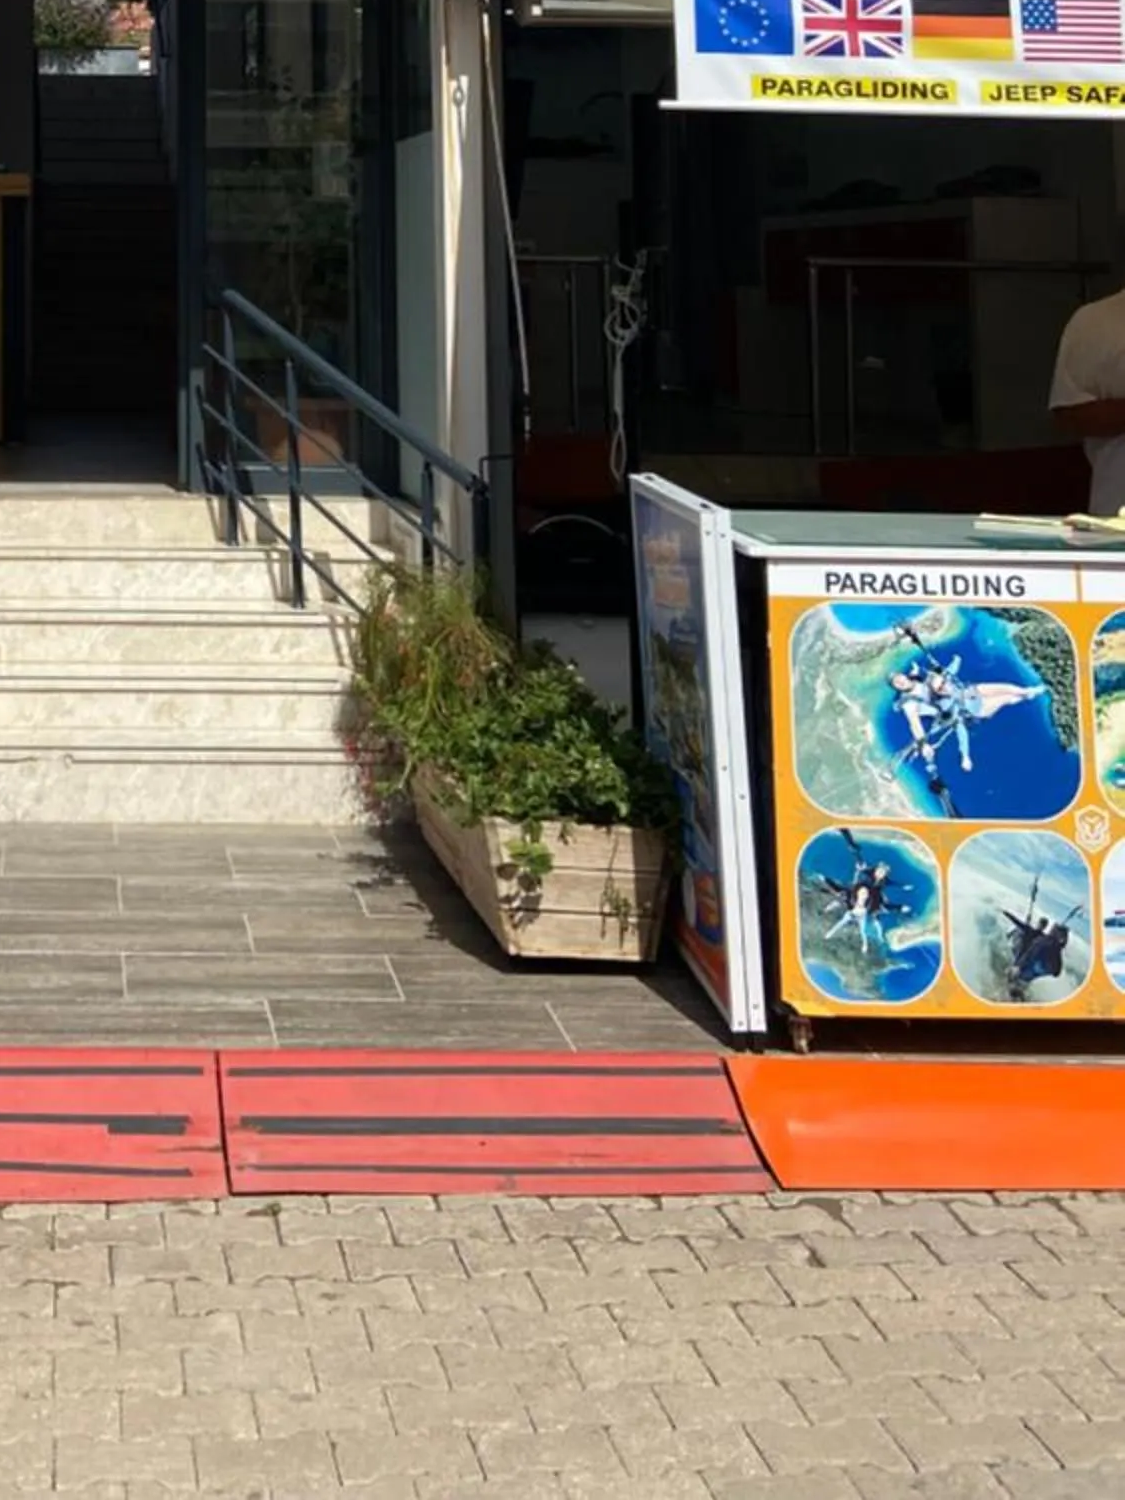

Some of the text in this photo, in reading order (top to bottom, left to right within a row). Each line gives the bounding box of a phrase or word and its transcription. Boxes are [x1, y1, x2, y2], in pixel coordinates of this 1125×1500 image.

[761, 78, 950, 101] PARAGLIDING
[989, 84, 1056, 102] JEEP
[825, 571, 1026, 597] PARAGLIDING
